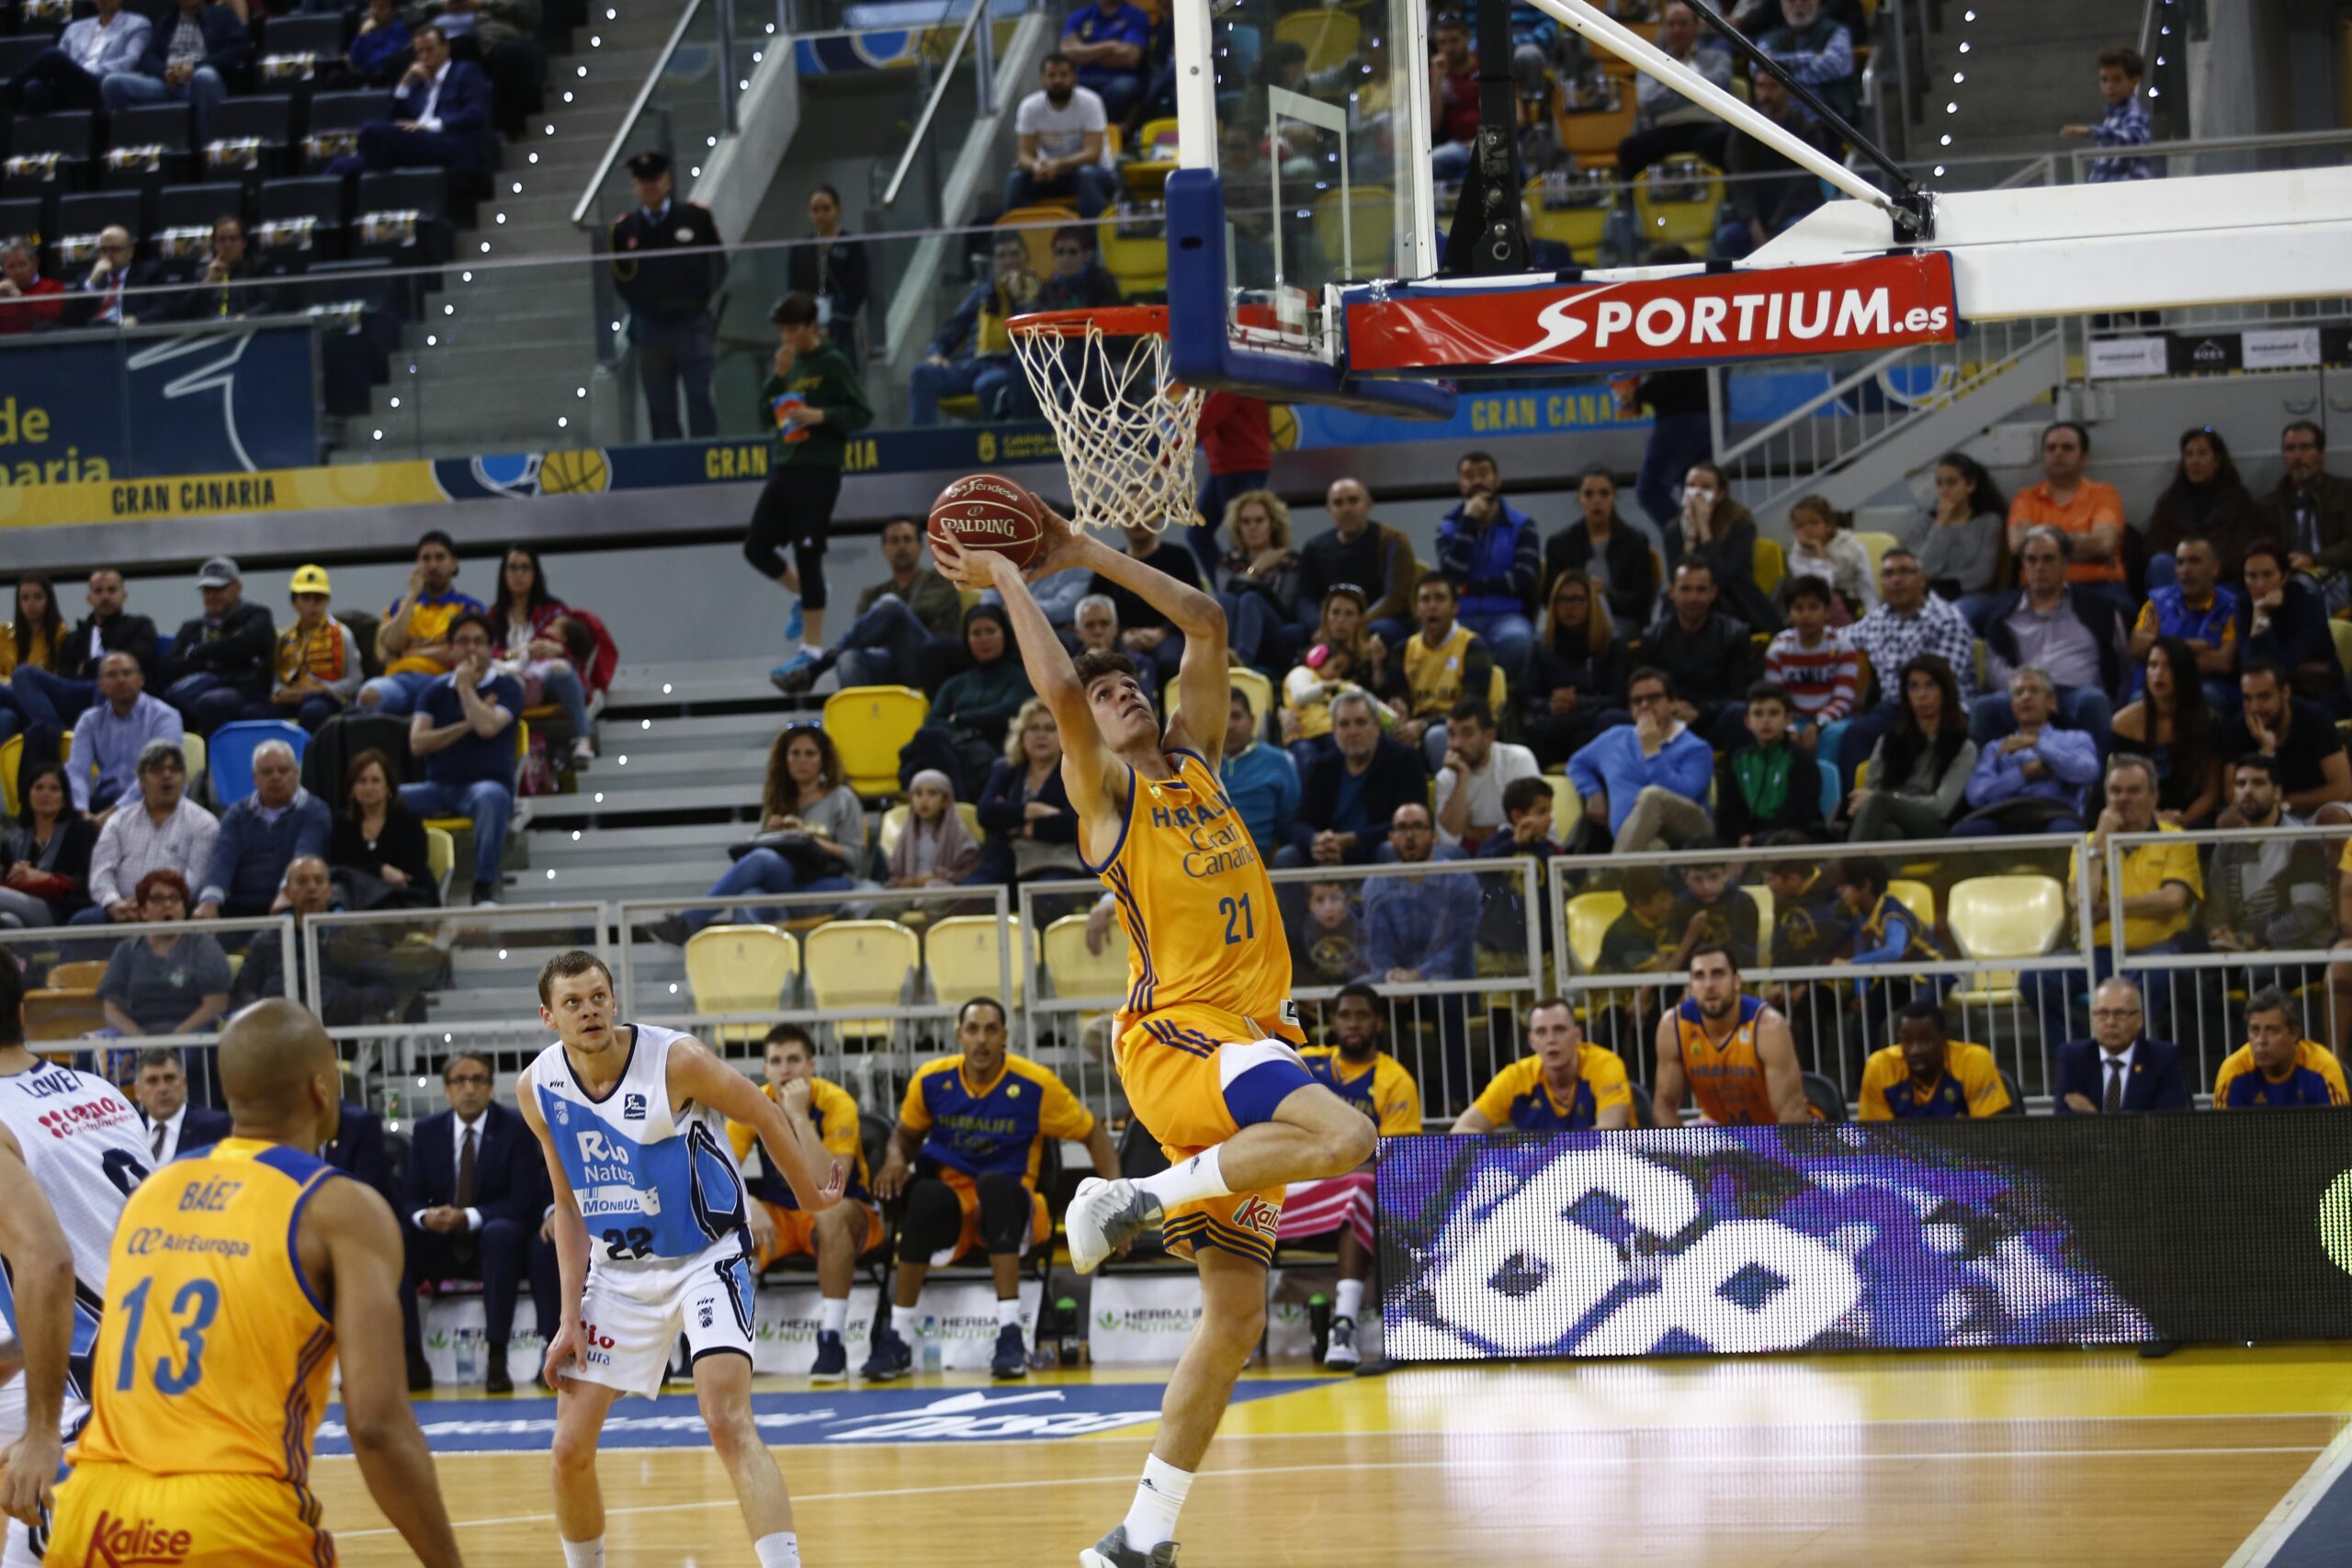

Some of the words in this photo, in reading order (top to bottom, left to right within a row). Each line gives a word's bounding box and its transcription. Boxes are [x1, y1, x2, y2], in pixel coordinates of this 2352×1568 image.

[1489, 281, 1948, 365] SPORTIUM.es
[1472, 398, 1538, 432] GRAN
[705, 445, 768, 479] GRAN
[111, 484, 170, 515] GRAN
[180, 478, 276, 511] CANARIA
[940, 517, 1015, 537] SPALDING
[1218, 892, 1254, 945] 21
[1238, 1195, 1280, 1232] Kali
[603, 1227, 654, 1260] 22
[116, 1275, 220, 1396] 13
[581, 1320, 615, 1349] io
[84, 1509, 192, 1568] Kalise
